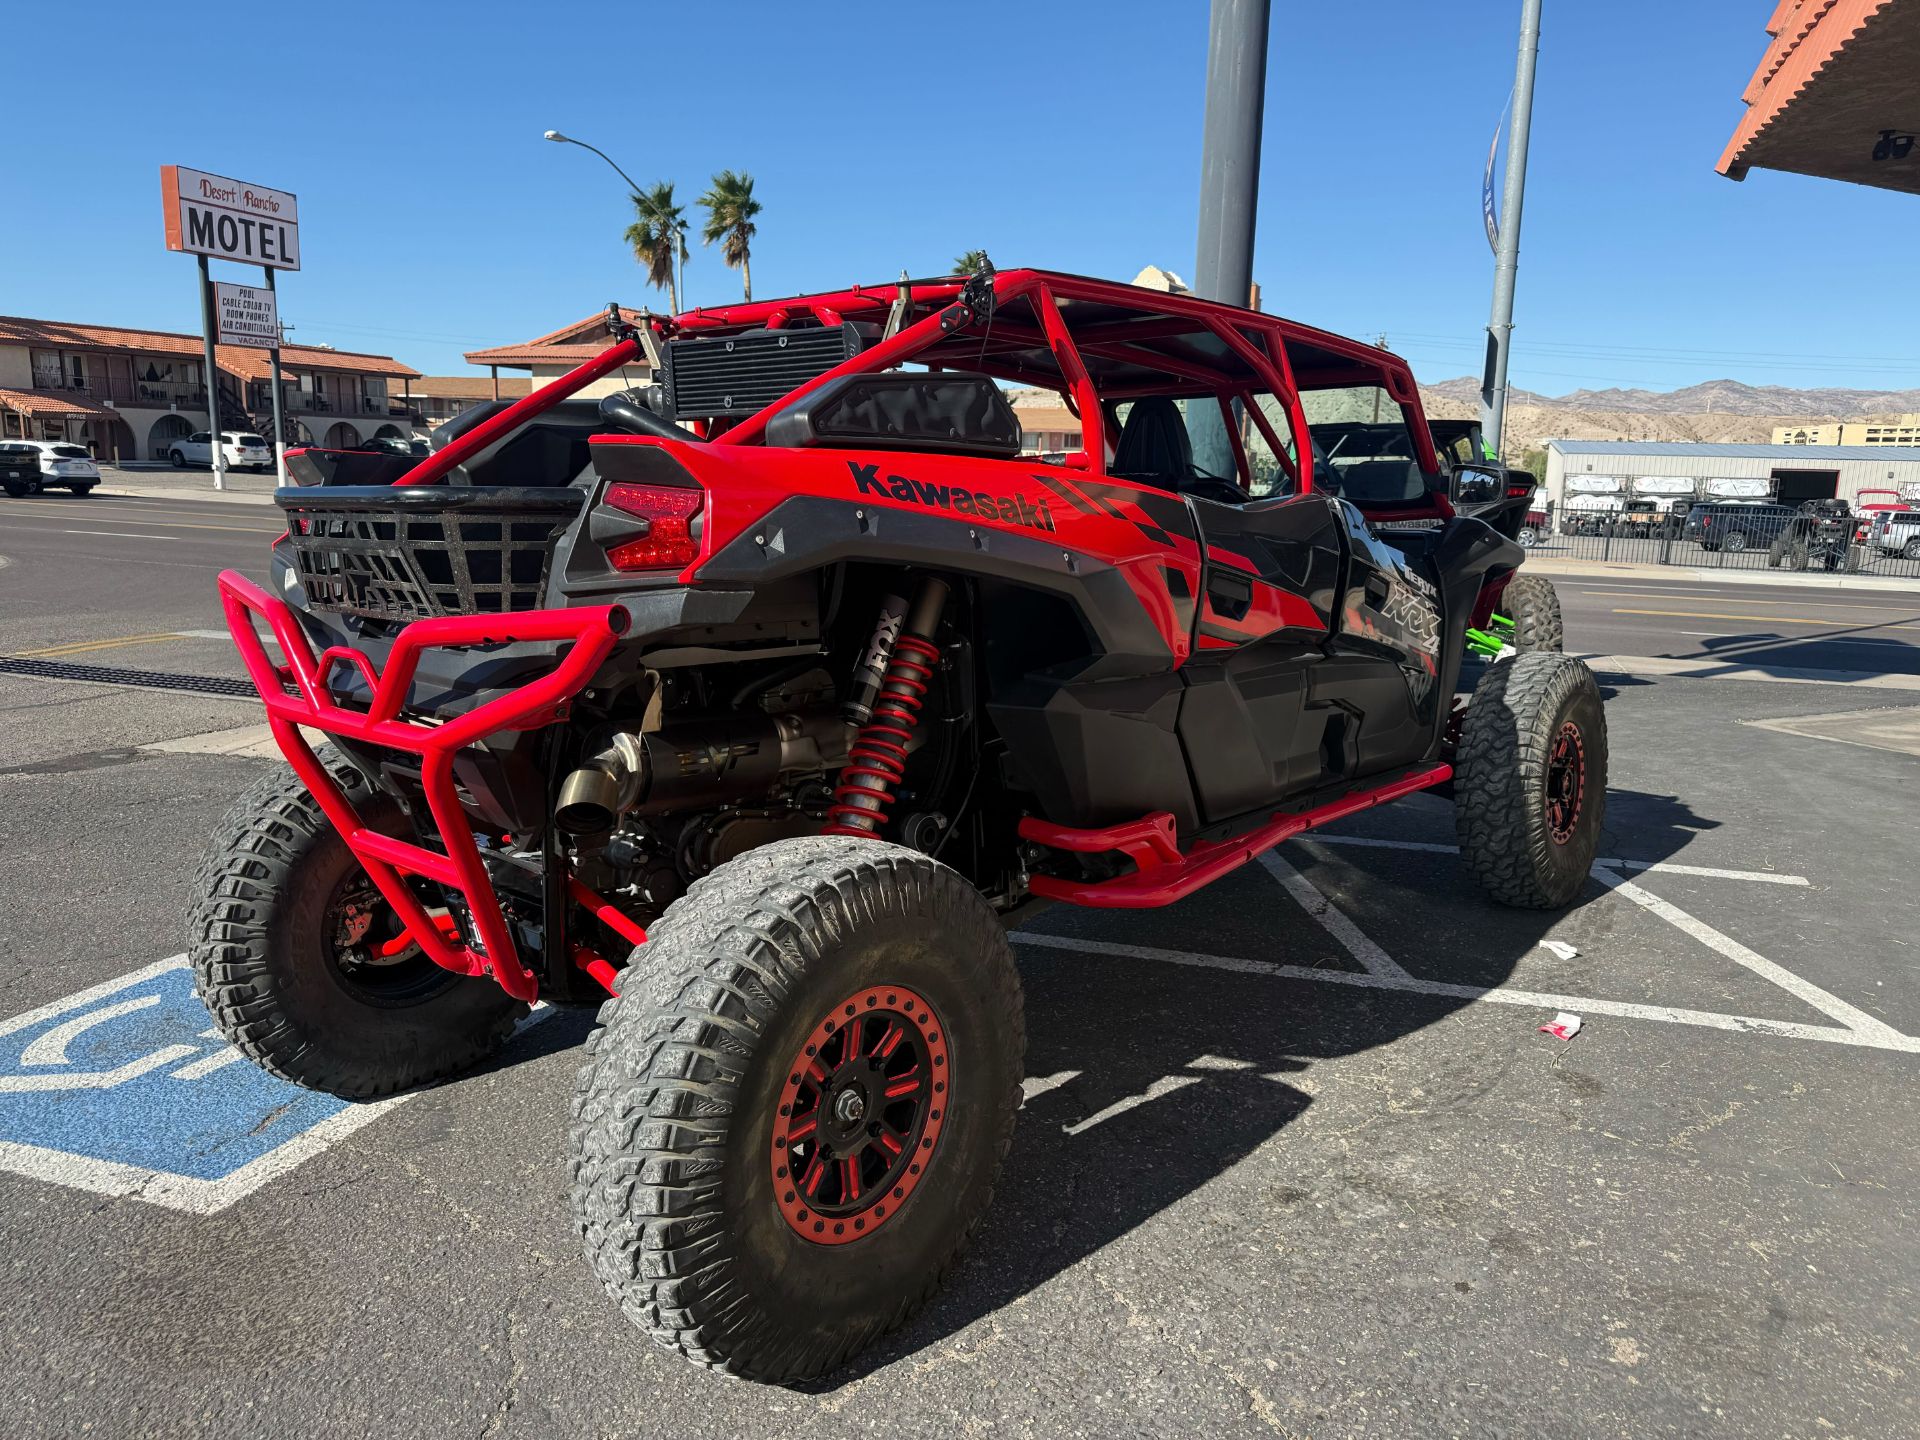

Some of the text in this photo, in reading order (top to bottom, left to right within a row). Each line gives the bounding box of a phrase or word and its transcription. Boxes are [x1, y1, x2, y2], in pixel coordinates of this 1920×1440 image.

[200, 179, 280, 213] Desert Rancho
[188, 207, 294, 264] MOTEL
[239, 288, 255, 299] POOL
[222, 297, 272, 312] CABLE COLOR TV
[226, 308, 270, 323] ROOM PHONES
[222, 319, 234, 330] AIR
[238, 336, 275, 346] VACANCY
[847, 460, 1056, 534] Kawasaki
[864, 608, 903, 673] FOX
[1422, 634, 1440, 654] 4
